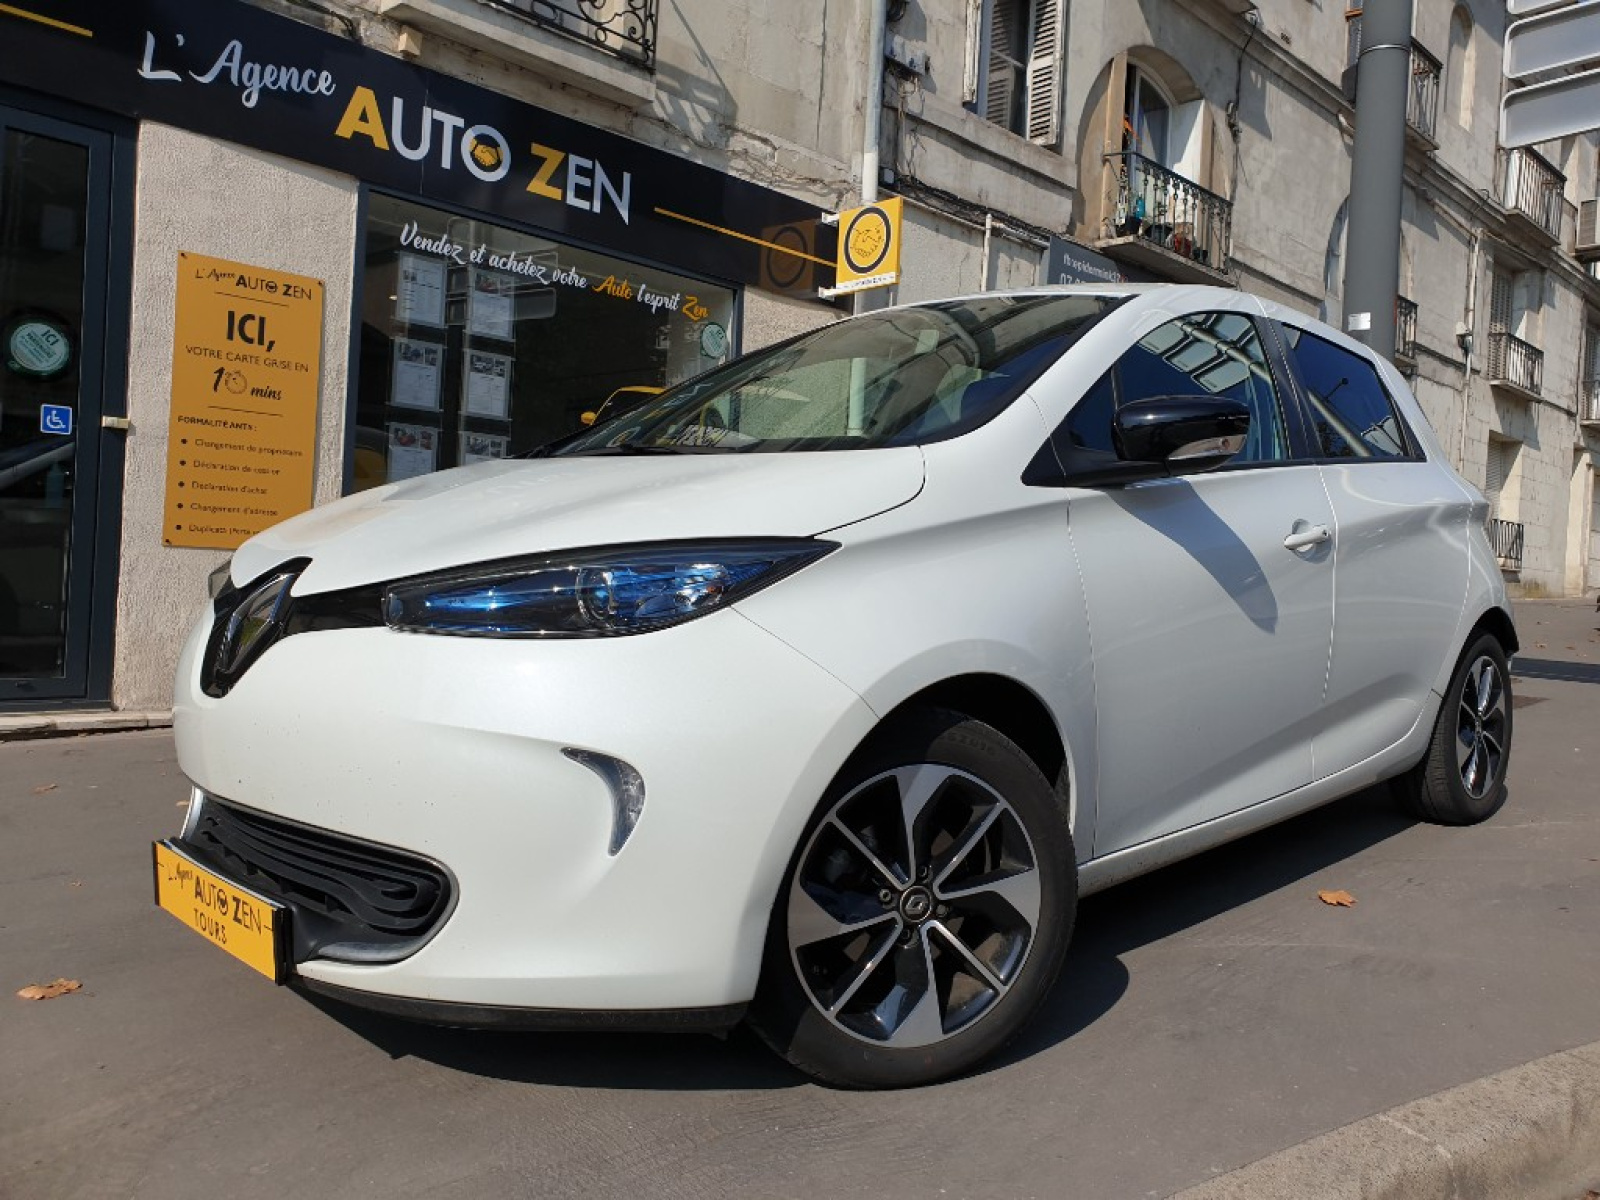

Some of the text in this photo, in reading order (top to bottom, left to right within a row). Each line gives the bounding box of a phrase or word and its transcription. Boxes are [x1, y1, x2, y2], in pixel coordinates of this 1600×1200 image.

[189, 39, 336, 108] Agence
[335, 85, 511, 182] AUTO
[526, 142, 631, 225] ZEN
[235, 274, 278, 293] AUTO
[282, 284, 312, 301] ZEN
[400, 220, 466, 264] Vendez
[469, 243, 487, 263] et
[489, 251, 550, 285] achetez
[552, 266, 588, 288] votre
[592, 274, 633, 300] Auto
[682, 294, 709, 322] Zen
[41, 329, 59, 346] ICI
[227, 310, 276, 353] ICI,
[185, 344, 309, 373] VOTRE CARTE GRISE EN
[250, 385, 282, 401] mins
[194, 874, 229, 917] AUTO
[232, 893, 262, 937] ZEN
[193, 907, 228, 945] TOURS
